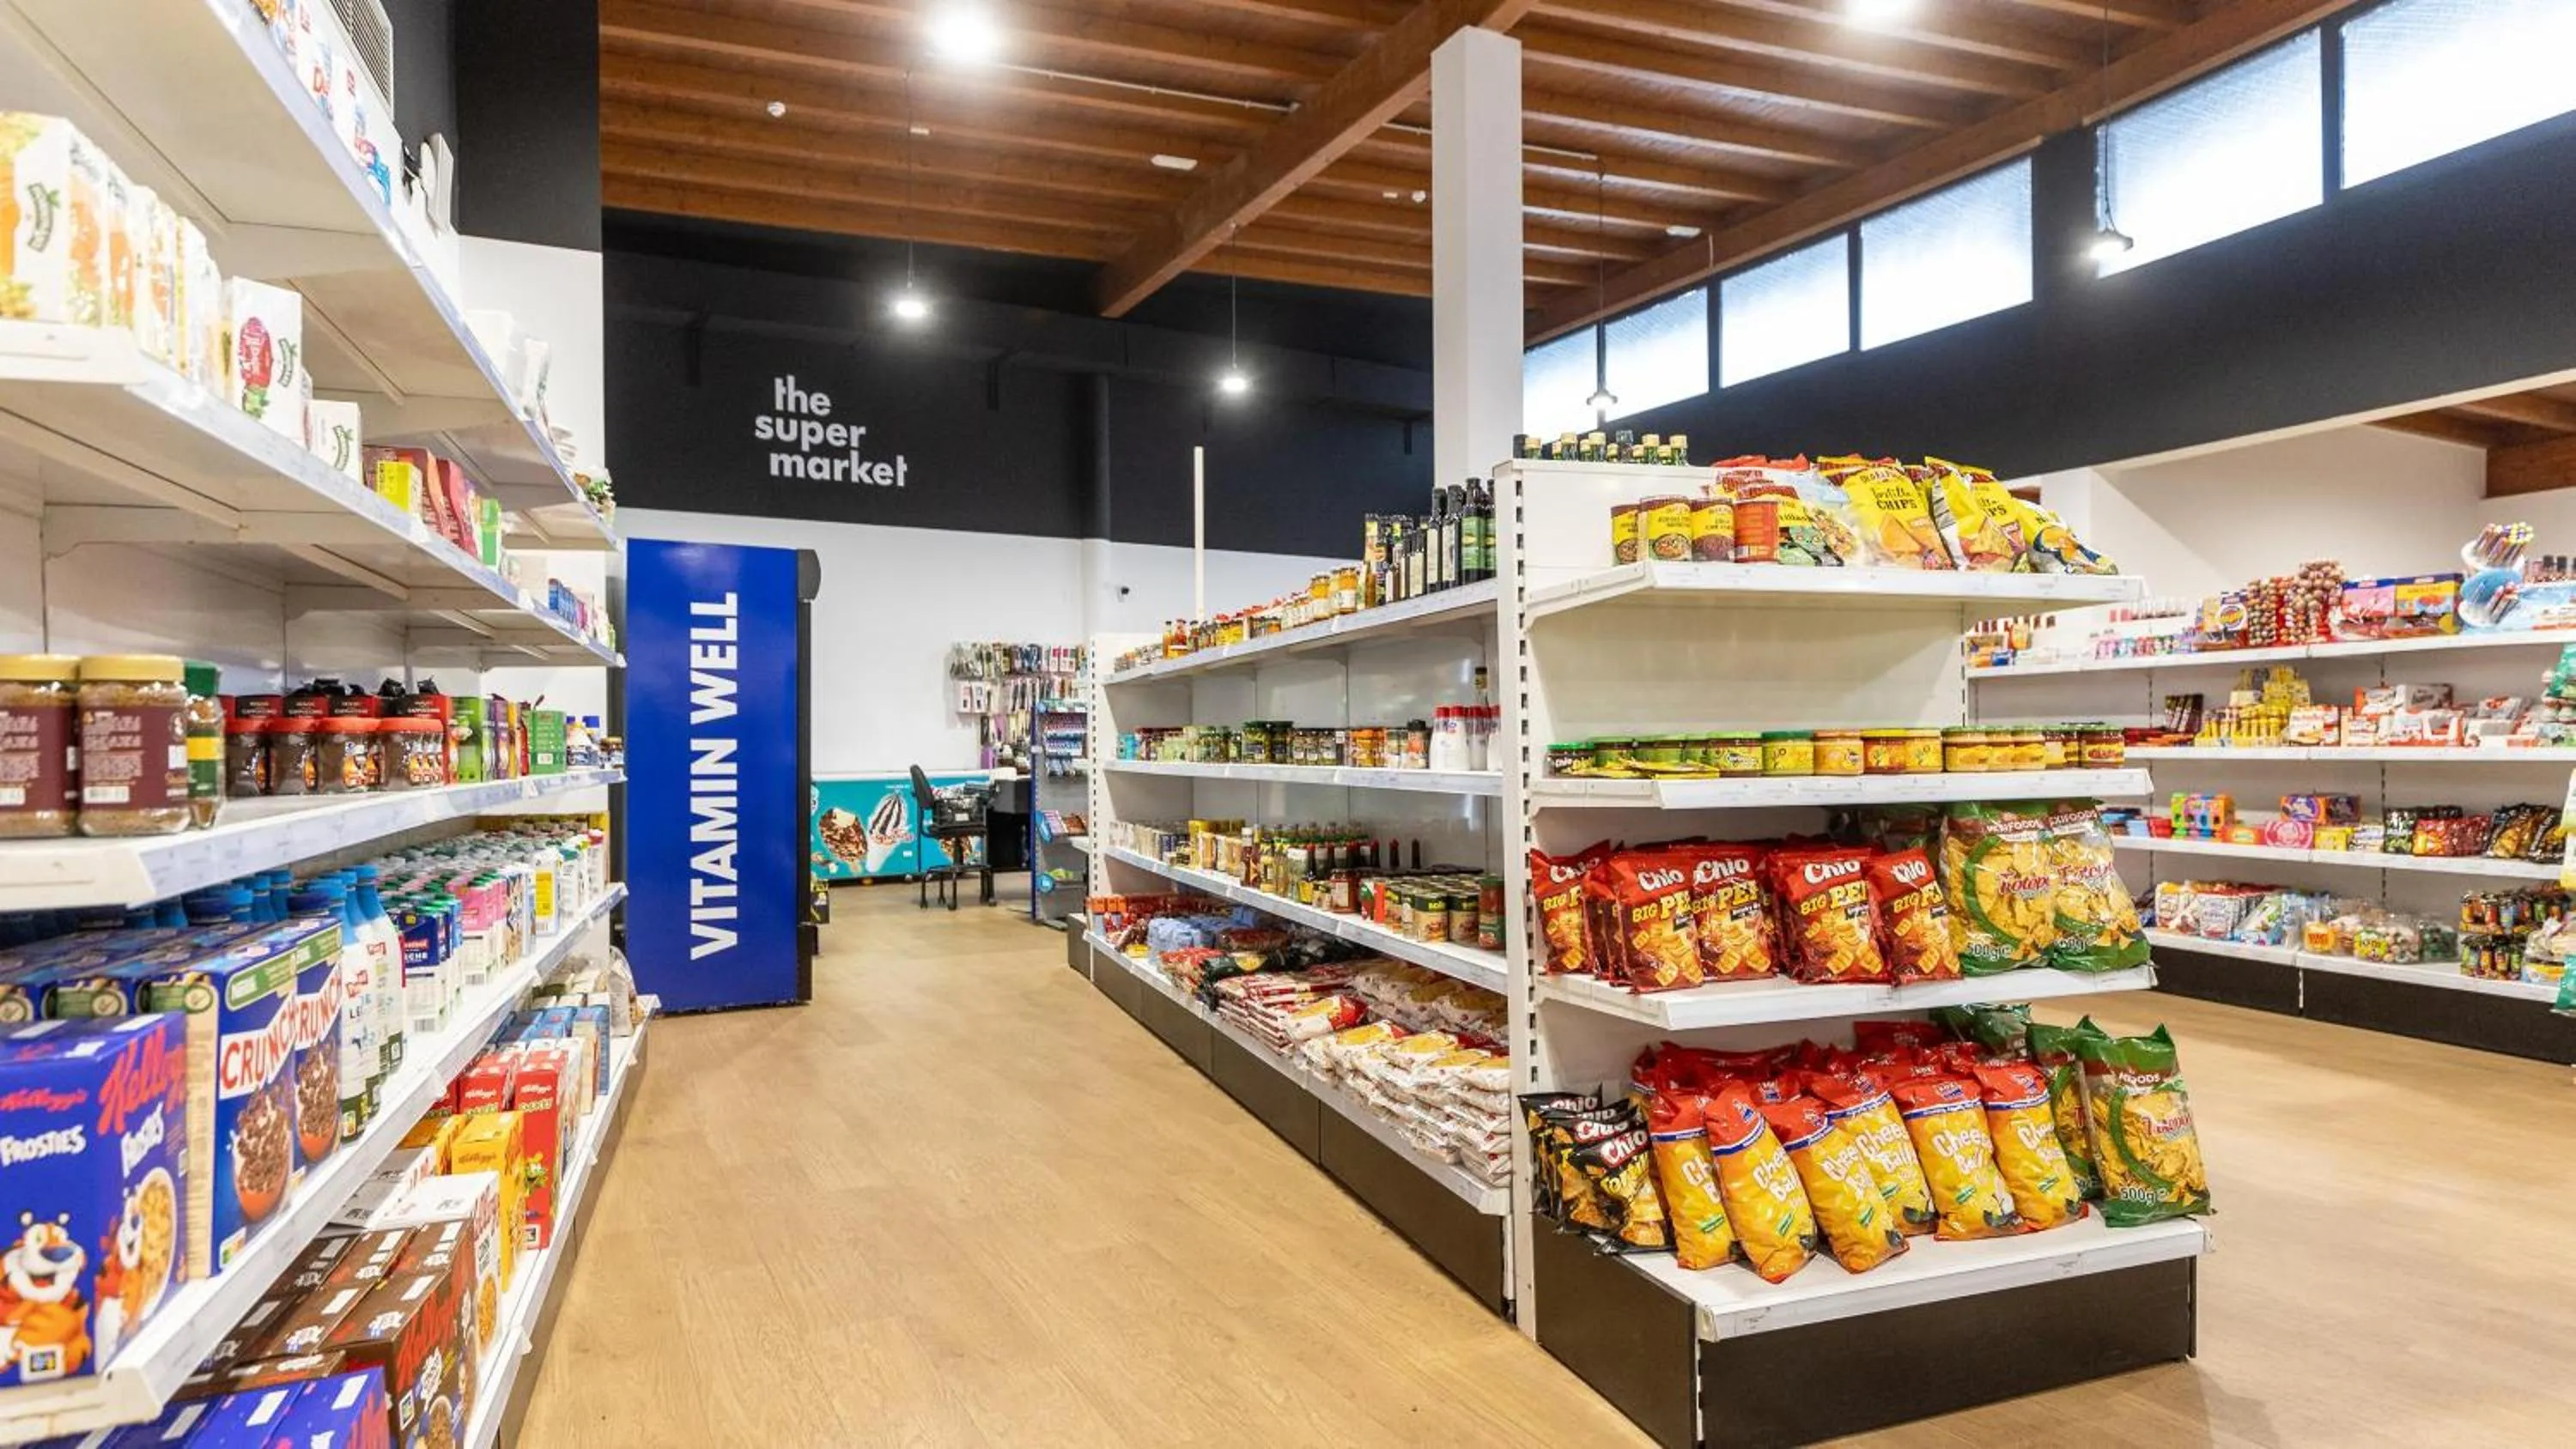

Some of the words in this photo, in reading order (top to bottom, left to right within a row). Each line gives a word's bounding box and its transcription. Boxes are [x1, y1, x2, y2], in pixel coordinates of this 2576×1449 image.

[775, 374, 831, 416] the
[755, 415, 866, 452] super
[769, 449, 908, 487] market
[1875, 498, 1918, 511] CHIPS
[690, 592, 738, 724] WELL
[690, 738, 738, 961] VITAMIN
[1637, 867, 1685, 892] Chio
[1692, 858, 1750, 883] Chio
[1804, 860, 1860, 884] Chio
[1893, 860, 1927, 882] Chio
[1543, 894, 1567, 912] BIG
[1632, 902, 1658, 923] BIG
[1800, 894, 1826, 916] BIG
[1893, 892, 1920, 913] BIG
[1549, 1095, 1599, 1113] Chio
[0, 1123, 87, 1167] FROSTIES
[1600, 1128, 1648, 1167] Chio
[2119, 1187, 2156, 1206] 500g
